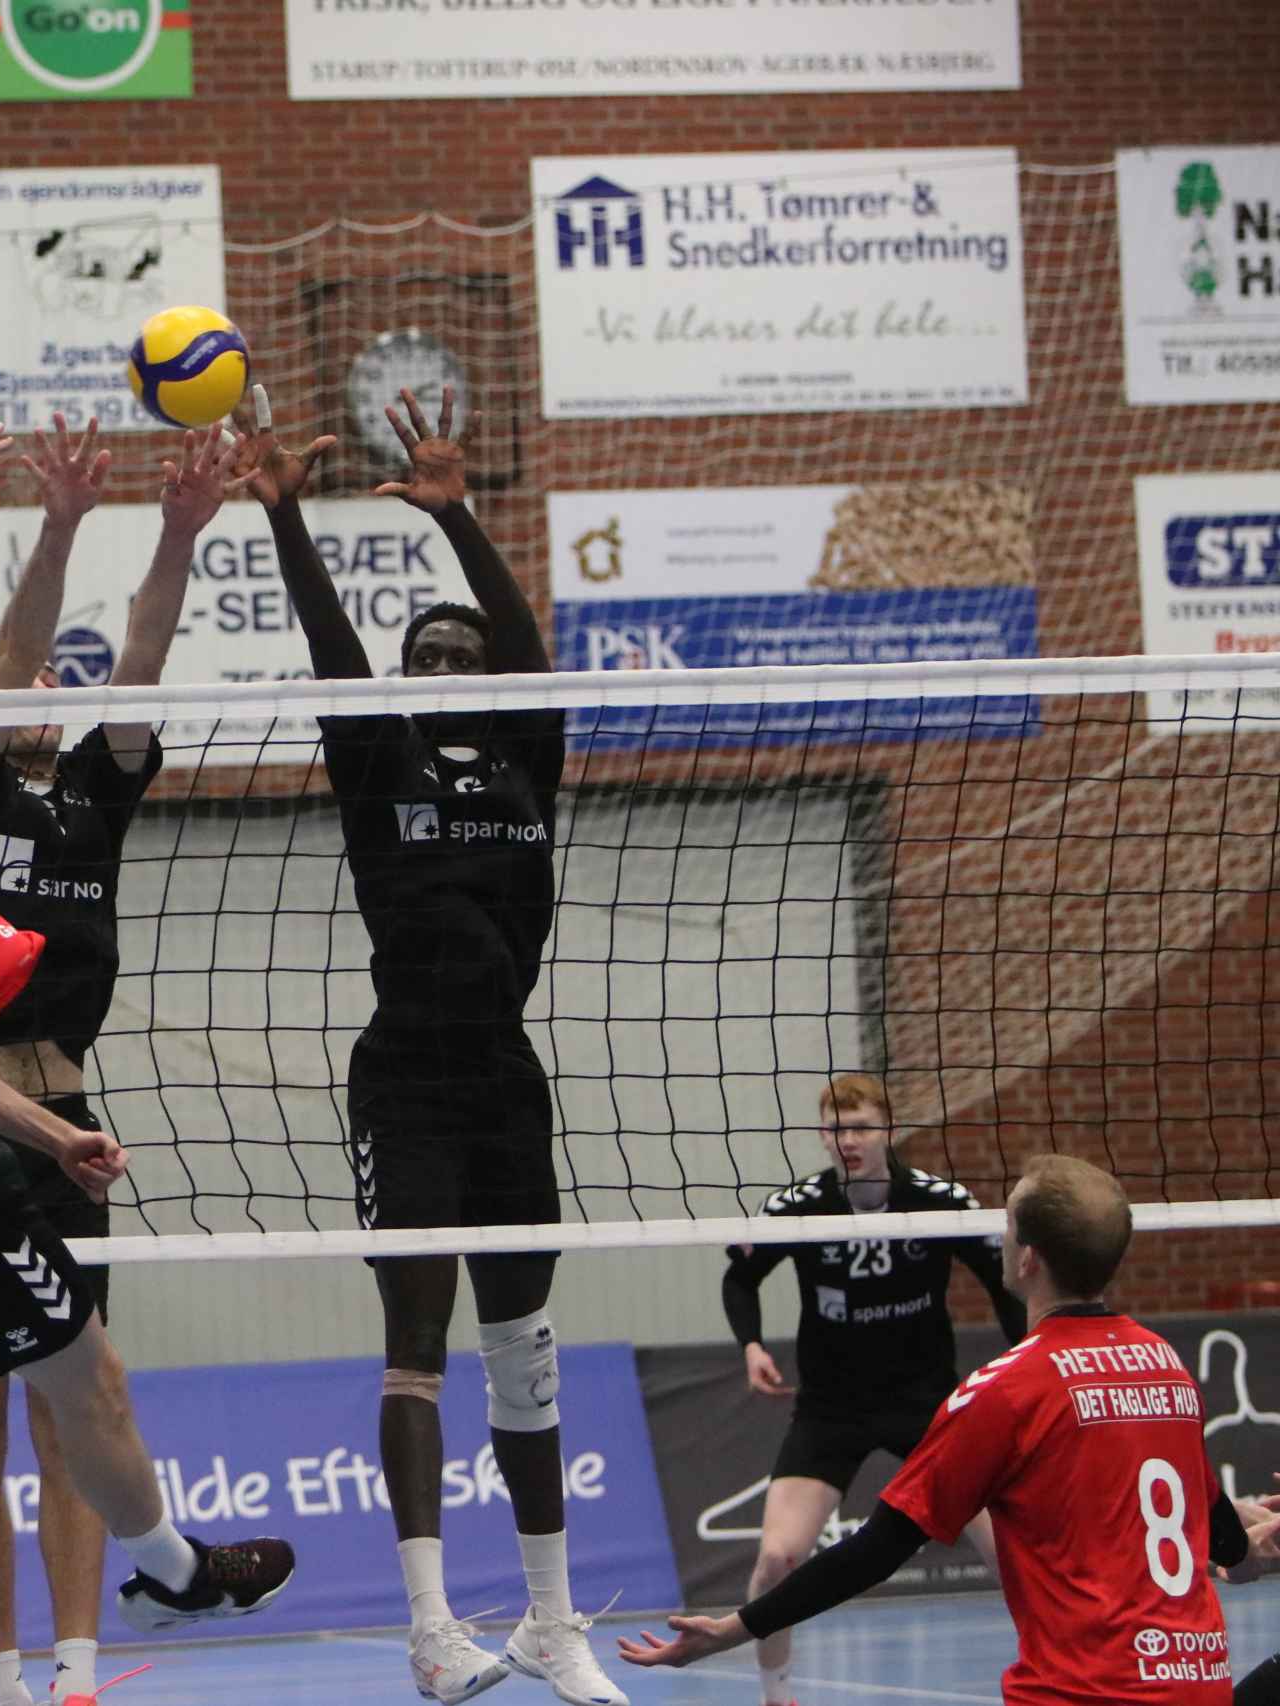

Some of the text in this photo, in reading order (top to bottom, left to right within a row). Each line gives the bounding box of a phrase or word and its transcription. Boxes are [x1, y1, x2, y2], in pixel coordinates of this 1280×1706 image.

[25, 5, 140, 33] Go'on
[662, 186, 748, 223] H.H.
[912, 182, 941, 217] &
[667, 221, 1009, 273] Snedkerforretning
[794, 303, 859, 340] det
[1196, 527, 1280, 579] ST
[450, 821, 504, 844] spar
[847, 1239, 893, 1279] 23
[1076, 1385, 1201, 1420] DET FAGLIGE HUS
[1138, 1457, 1195, 1598] 8
[1138, 1656, 1199, 1681] Louis
